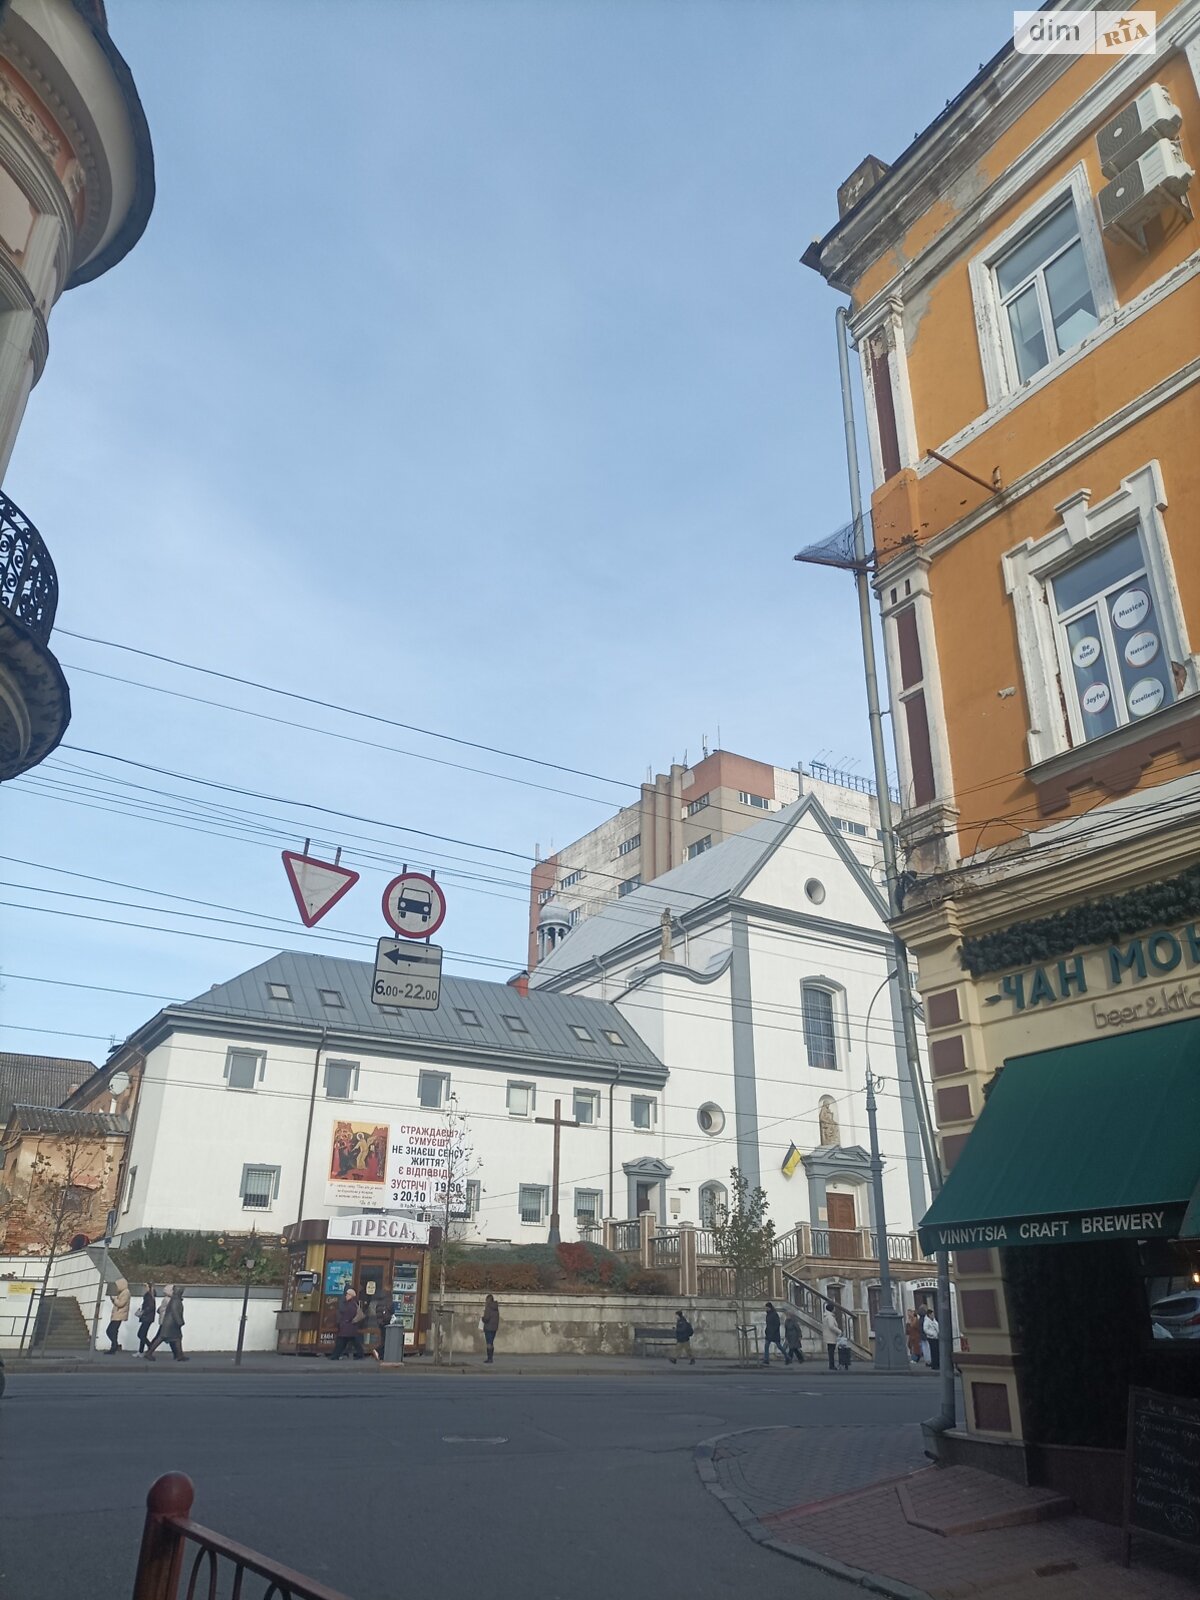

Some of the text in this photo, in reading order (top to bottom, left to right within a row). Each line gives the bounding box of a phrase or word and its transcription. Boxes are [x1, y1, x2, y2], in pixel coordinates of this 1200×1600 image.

[1118, 600, 1145, 618] Musical
[1130, 640, 1155, 656] Naturally
[1086, 690, 1106, 705] Joyful
[1131, 688, 1161, 706] Excellence
[400, 1125, 459, 1138] СТРАЖДАЄШ?
[409, 1136, 450, 1147] СУМУЄШ?
[392, 1145, 403, 1154] НЕ
[405, 1146, 436, 1157] ЗНАЄШ
[411, 1157, 445, 1167] ЖИТТЯ?
[398, 1166, 452, 1180] Є ВІДПОВІД
[391, 1178, 427, 1191] ЗУСТРІЧІ
[400, 1191, 426, 1203] 20.10
[350, 1219, 409, 1239] ПРЕСА
[938, 1211, 1164, 1245] VINNYTSIA CRAFT BREWERY
